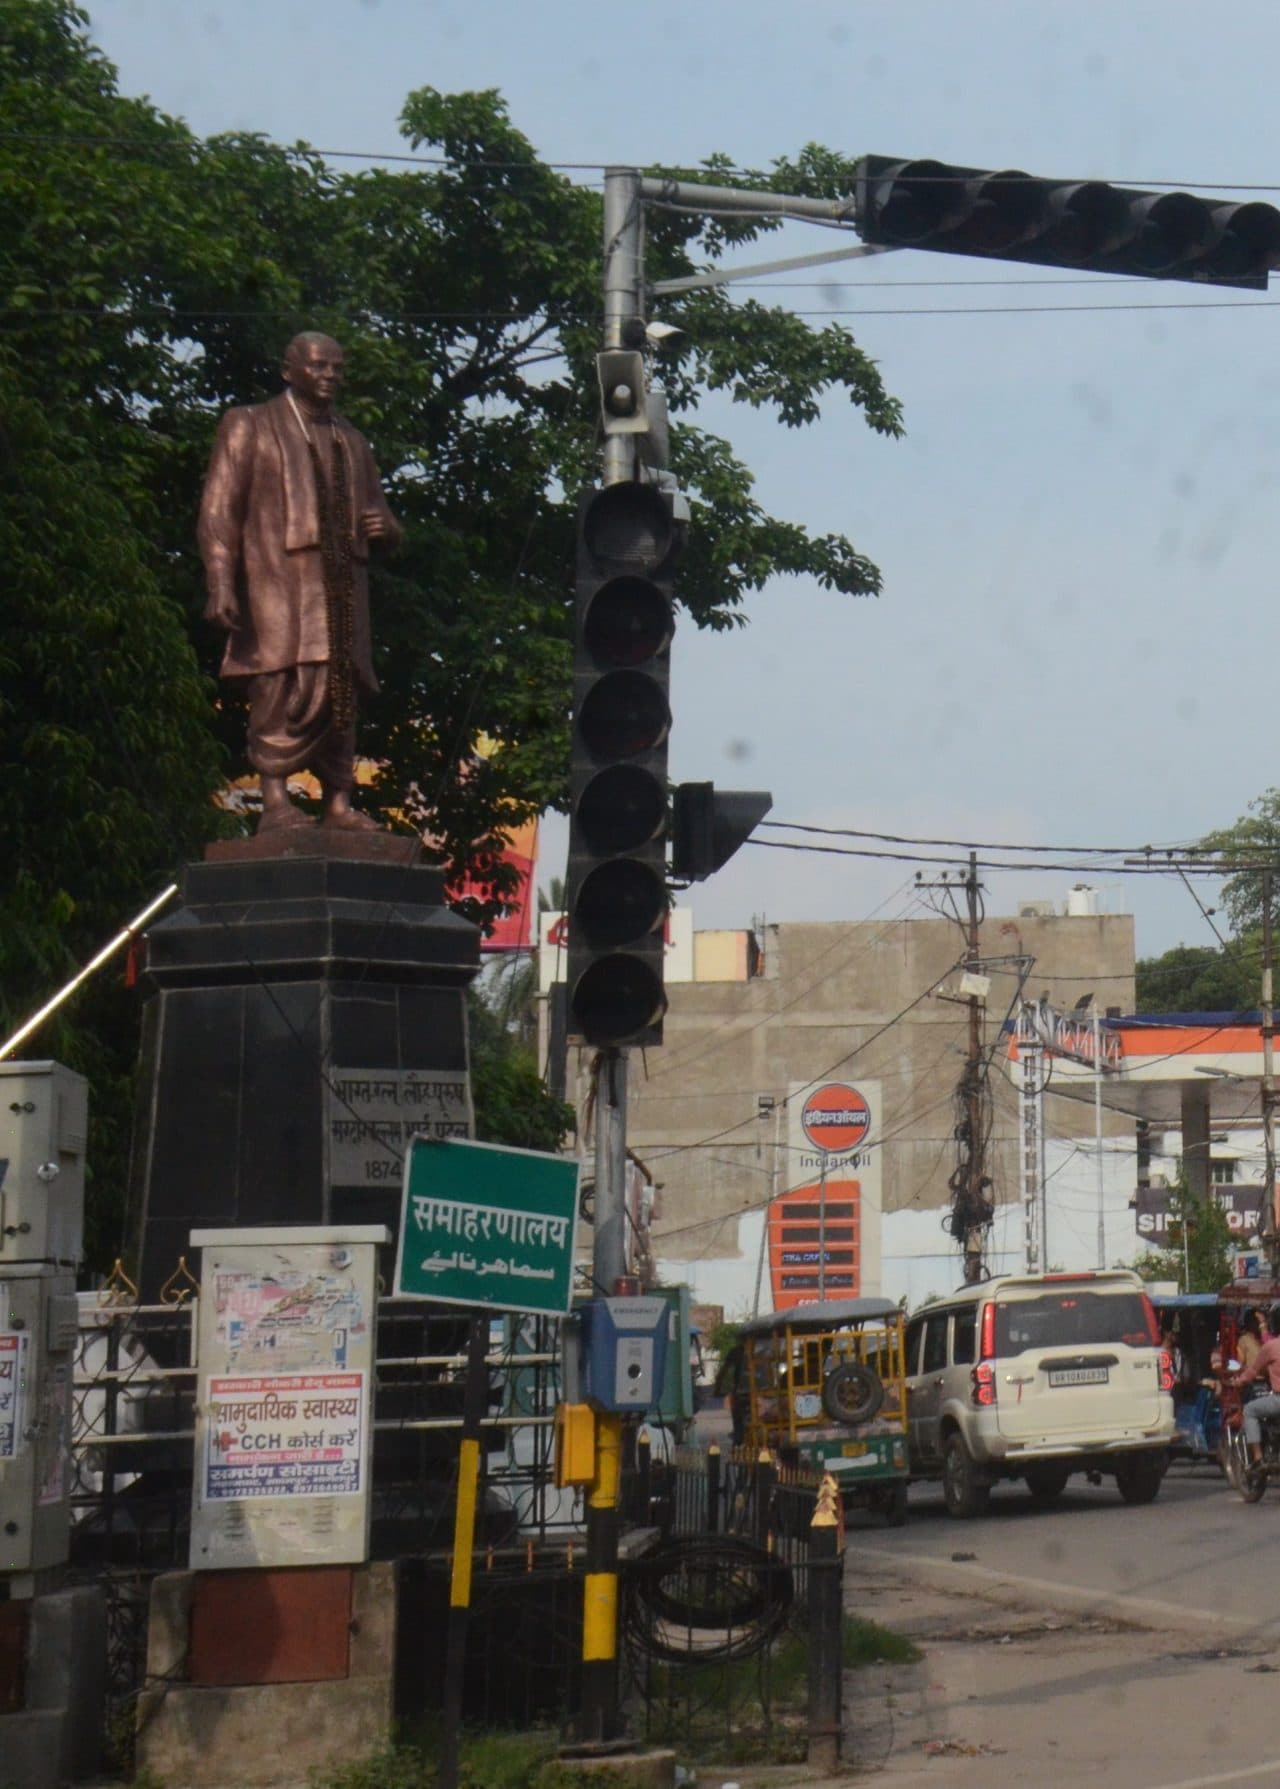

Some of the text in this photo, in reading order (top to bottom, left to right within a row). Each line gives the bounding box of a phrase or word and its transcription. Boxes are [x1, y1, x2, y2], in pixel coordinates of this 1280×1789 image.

[411, 1196, 570, 1250] समाहरणालय
[216, 1392, 359, 1434] सामुदायिक स्वास्थ्य
[241, 1427, 357, 1451] CCH कोर्स करें
